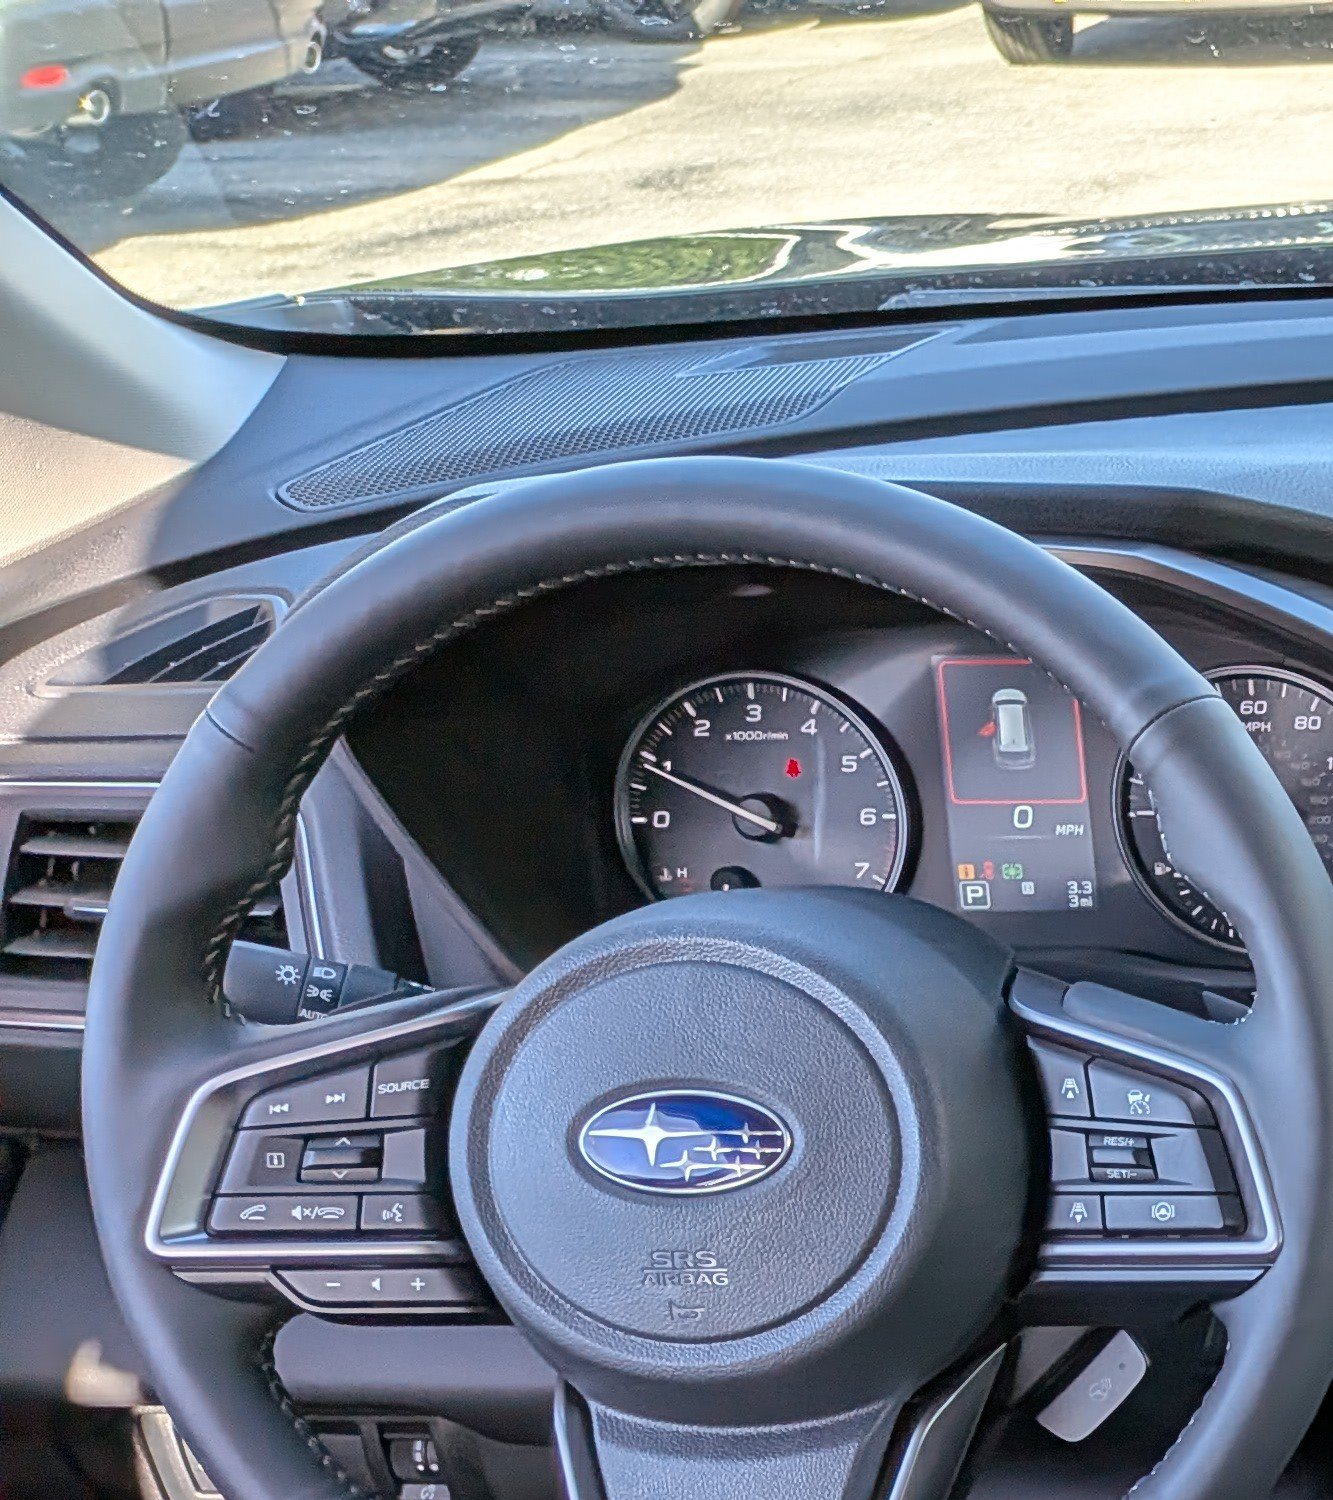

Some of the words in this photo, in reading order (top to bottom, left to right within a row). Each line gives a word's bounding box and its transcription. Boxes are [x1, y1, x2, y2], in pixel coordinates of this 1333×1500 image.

[745, 704, 763, 723] 3
[1240, 700, 1268, 715] 60
[693, 719, 711, 737] 2
[800, 718, 818, 736] 4
[1242, 721, 1272, 733] MPH
[1294, 715, 1322, 730] 80
[840, 755, 858, 773] 5
[652, 810, 671, 829] 0
[859, 808, 877, 826] 6
[1012, 804, 1034, 829] 0
[1055, 824, 1085, 837] MPH
[853, 862, 870, 879] 7
[1066, 880, 1093, 895] 3.3
[377, 1078, 430, 1095] SOURCE
[651, 1248, 718, 1268] SRS
[641, 1271, 729, 1287] AIRBAG
